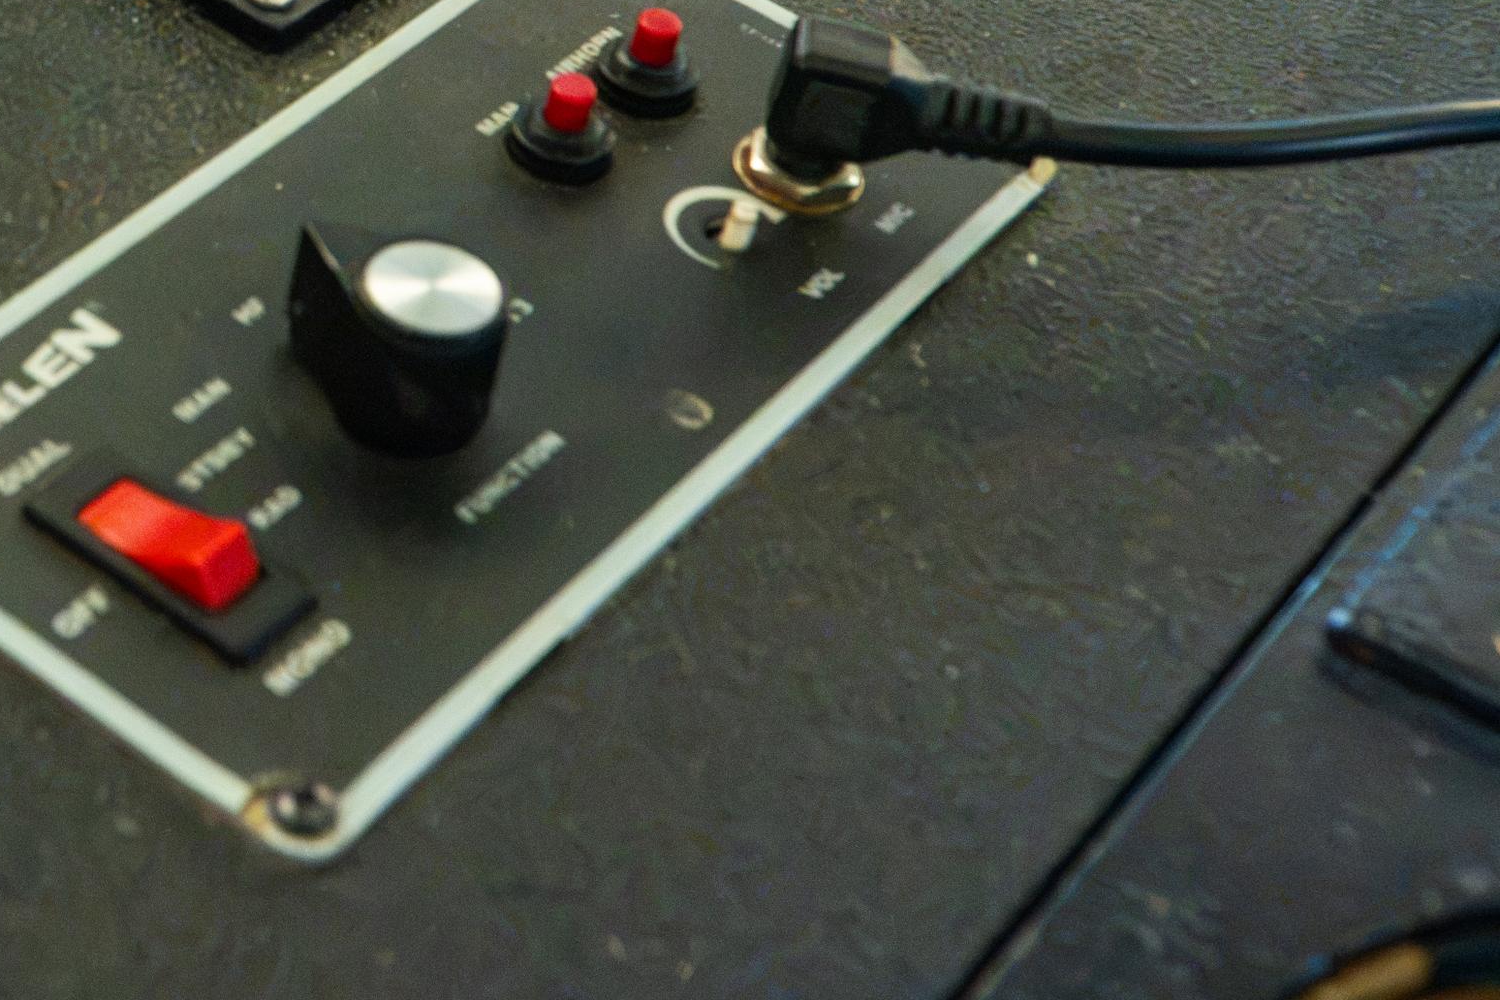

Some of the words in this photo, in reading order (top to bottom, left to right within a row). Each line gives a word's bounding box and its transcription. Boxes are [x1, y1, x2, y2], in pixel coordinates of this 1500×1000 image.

[453, 429, 567, 525] FUNCTION
[51, 586, 110, 639] OFF
[262, 618, 353, 696] MONO
